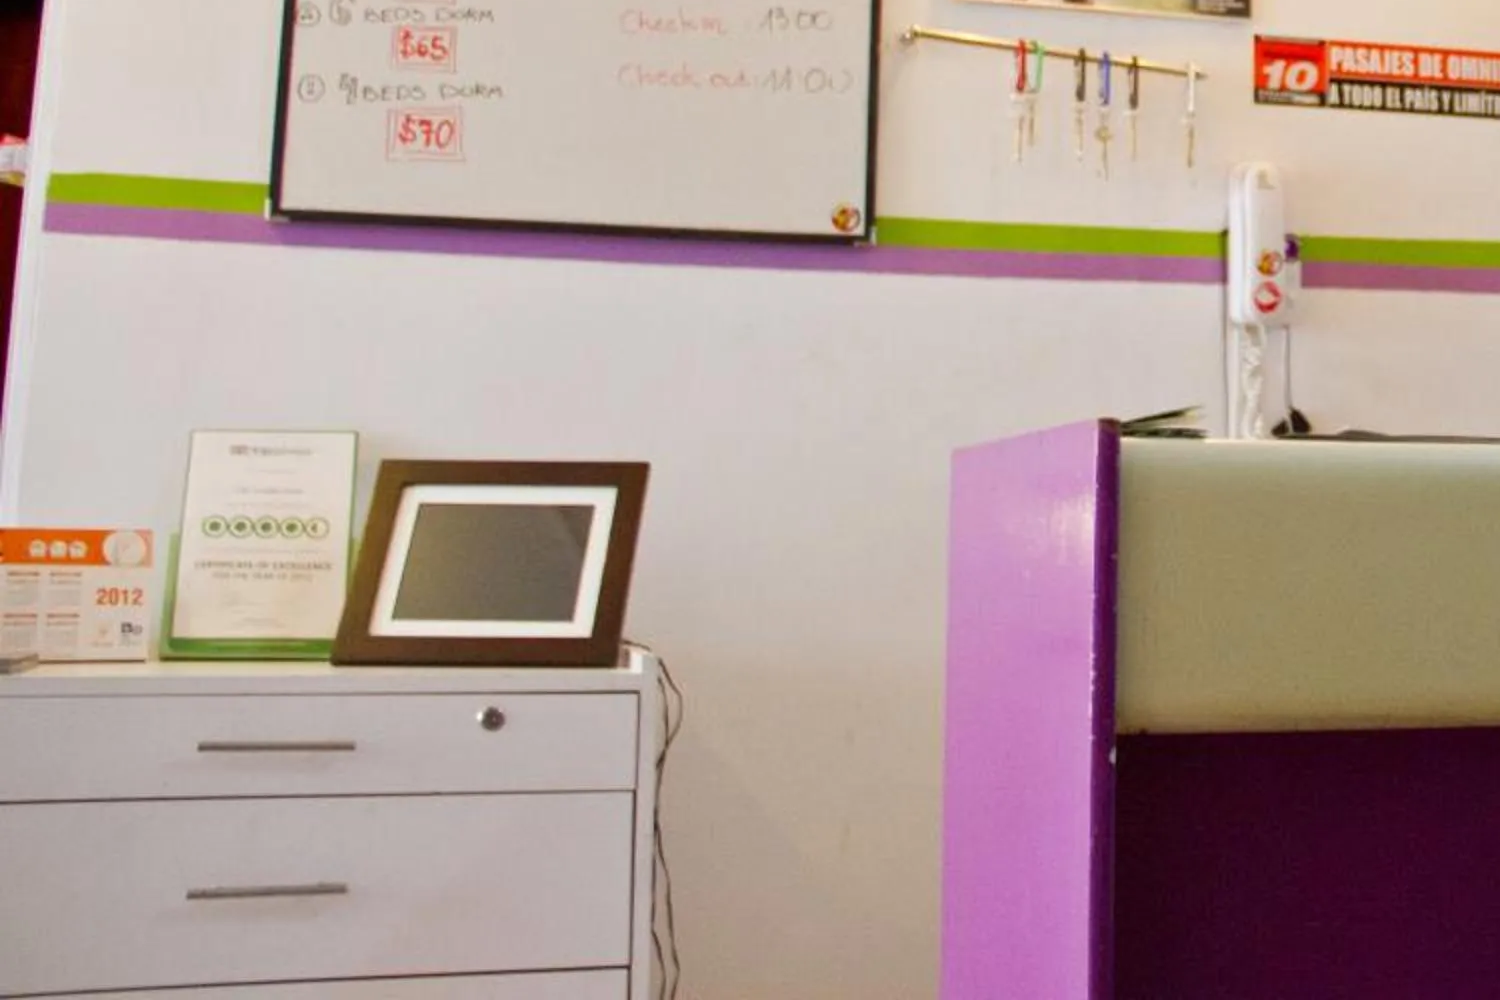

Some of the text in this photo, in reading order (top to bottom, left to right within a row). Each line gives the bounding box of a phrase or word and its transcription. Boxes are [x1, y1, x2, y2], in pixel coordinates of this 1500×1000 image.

[364, 7, 427, 23] BEDS
[399, 28, 449, 61] $65
[1262, 60, 1319, 92] 10
[1330, 45, 1416, 76] PASAJES
[1418, 51, 1444, 79] DE
[362, 86, 427, 102] BEDS
[1328, 82, 1341, 106] A
[1342, 83, 1383, 108] TODO
[1385, 85, 1402, 109] EL
[399, 114, 455, 149] $70
[96, 587, 144, 606] 2012
